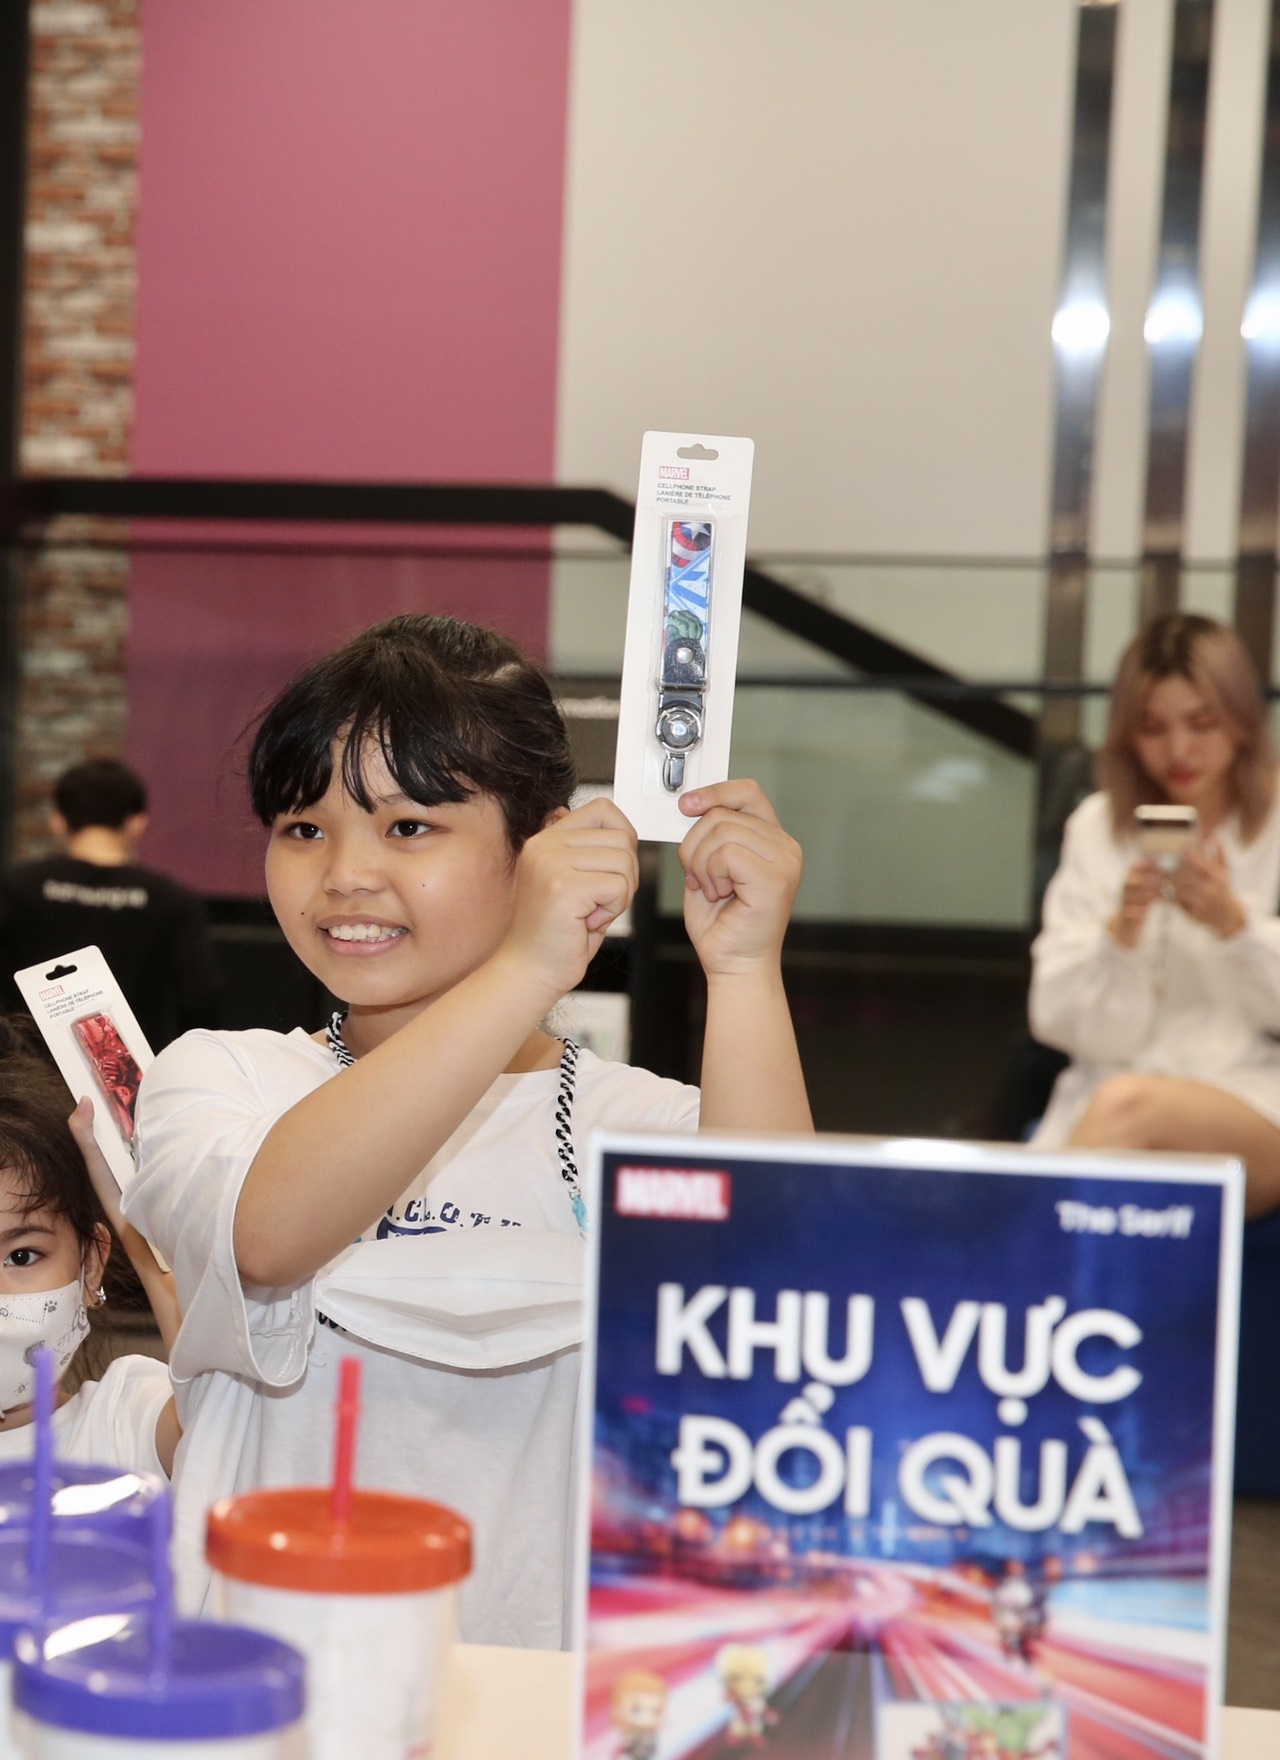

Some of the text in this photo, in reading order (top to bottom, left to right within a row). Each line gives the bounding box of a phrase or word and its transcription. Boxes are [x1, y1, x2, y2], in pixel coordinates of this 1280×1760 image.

[659, 466, 689, 480] MARVEL
[656, 497, 689, 505] PORTABLE
[39, 985, 64, 1001] MARVEL
[619, 1169, 729, 1220] MARVEL
[1056, 1201, 1194, 1239] The Serif
[655, 1282, 1143, 1426] KHU VỰC
[671, 1382, 1144, 1539] ĐỔI QUÀ
